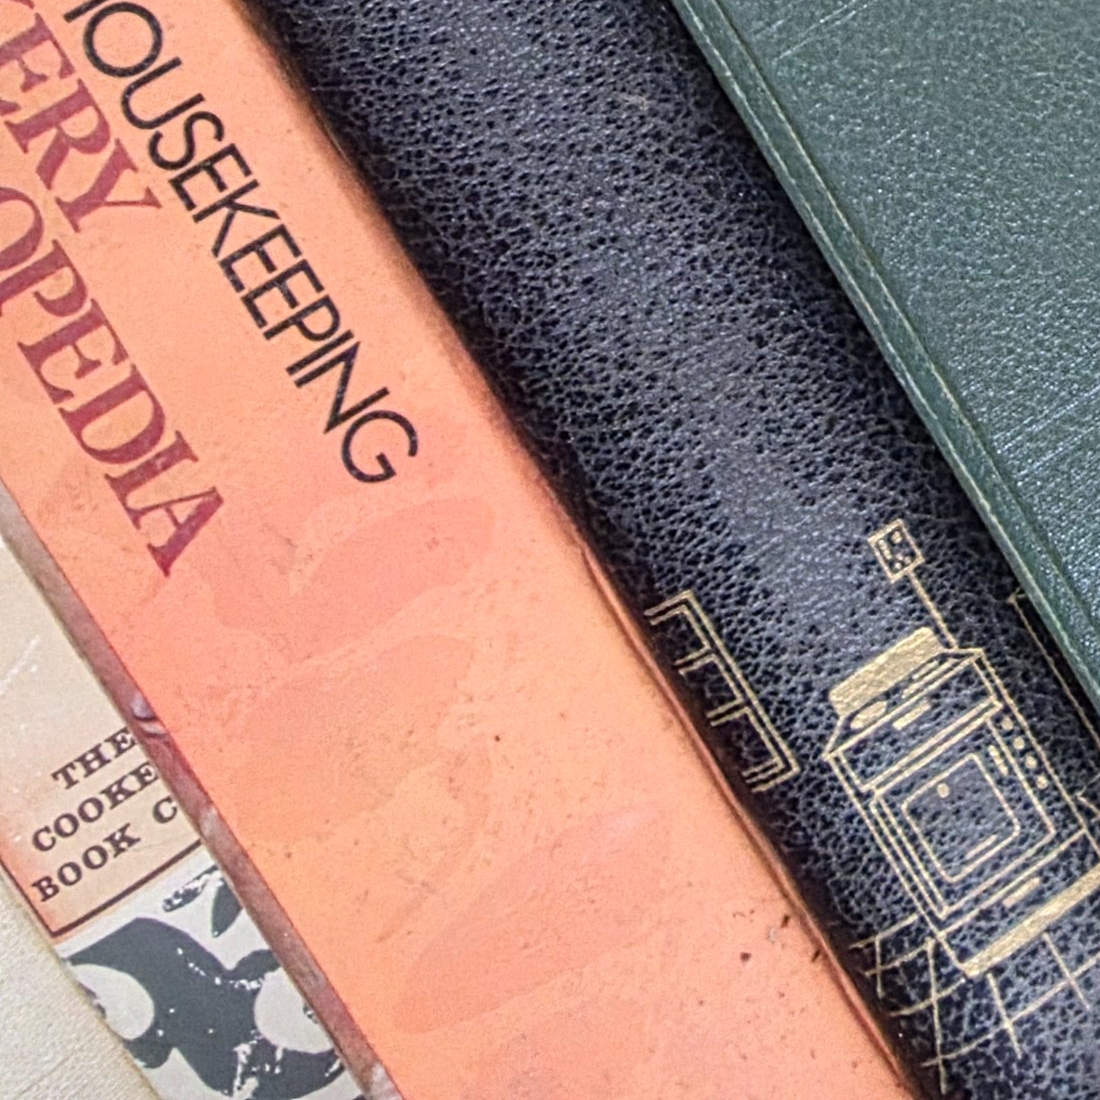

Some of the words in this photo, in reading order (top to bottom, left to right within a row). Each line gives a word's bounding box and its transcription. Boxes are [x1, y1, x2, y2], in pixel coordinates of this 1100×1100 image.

[51, 726, 138, 790] THE
[32, 761, 159, 852] COOKE
[31, 822, 142, 903] BOOK
